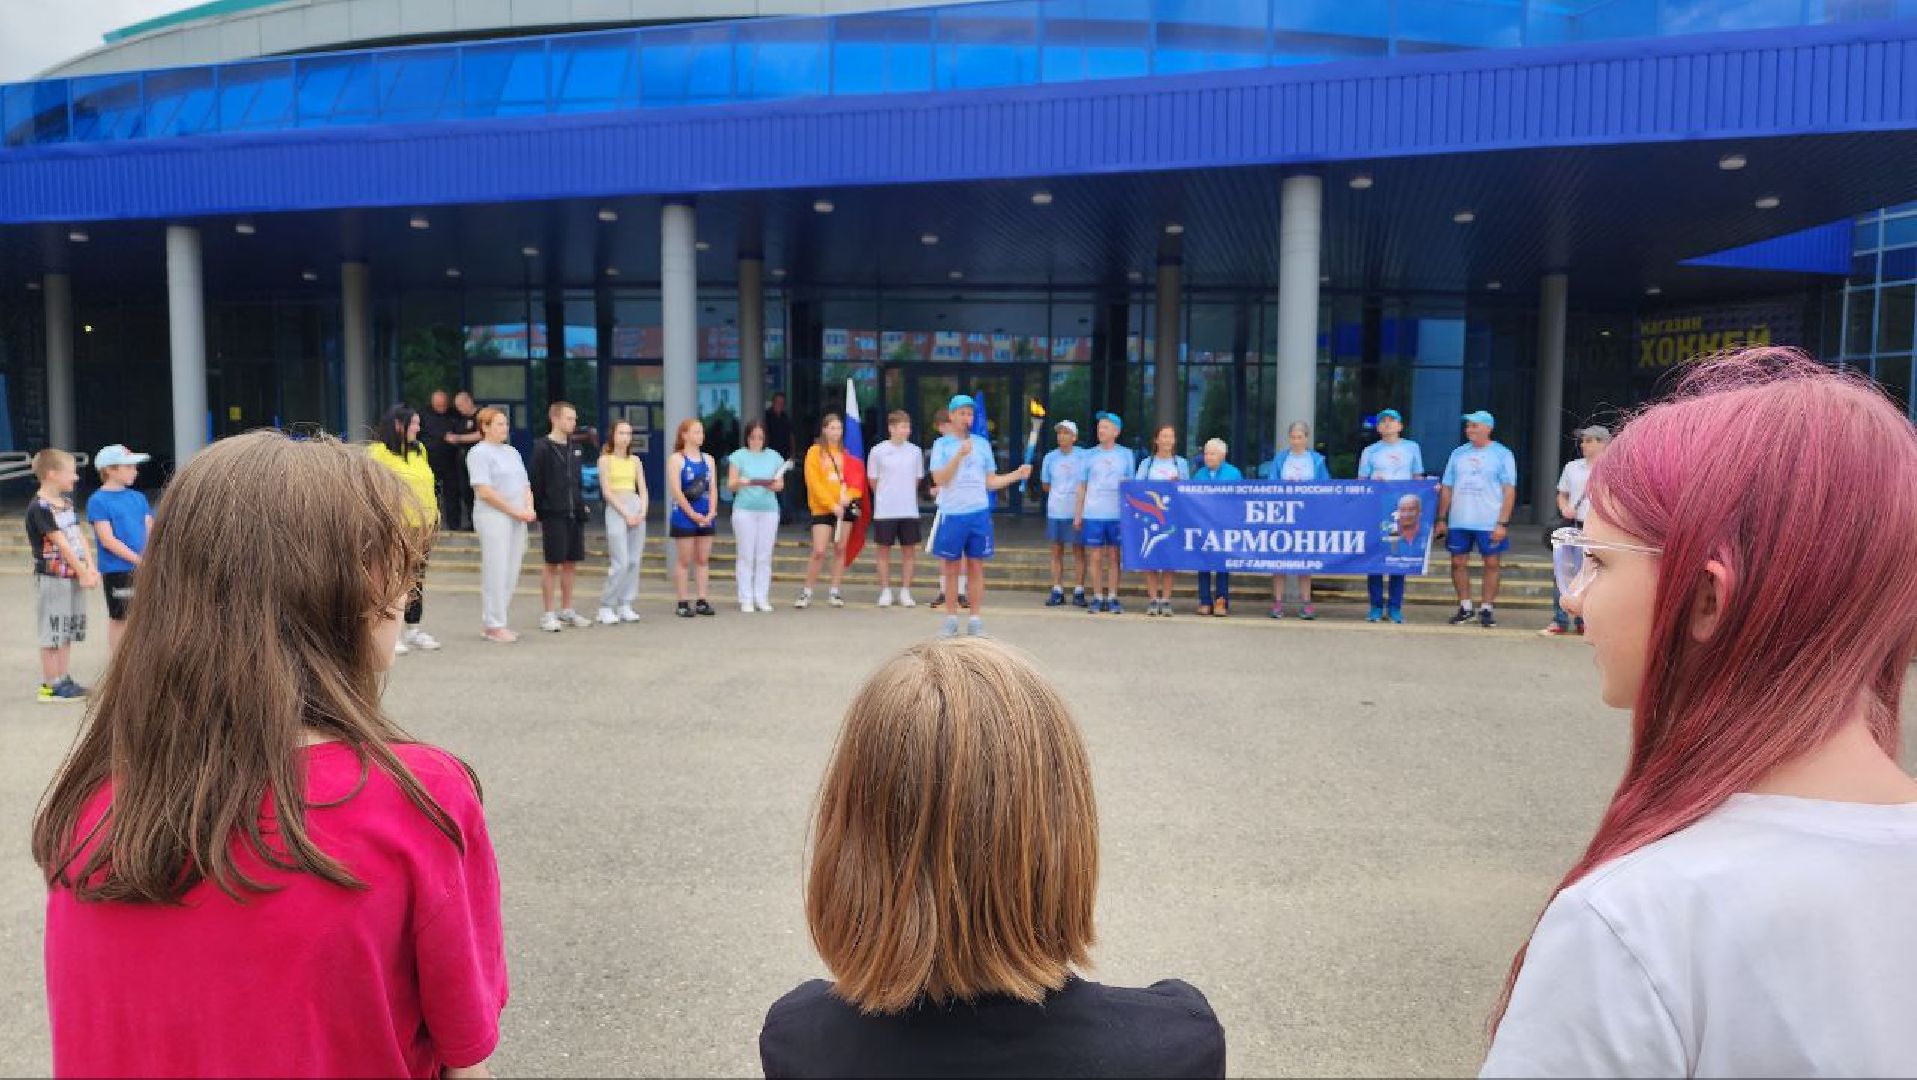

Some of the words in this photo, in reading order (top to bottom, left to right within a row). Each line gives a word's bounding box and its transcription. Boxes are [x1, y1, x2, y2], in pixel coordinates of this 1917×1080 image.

[1641, 317, 1702, 335] МАГАЗИН
[1177, 485, 1233, 495] ФАКЕЛЬНАЯ
[1235, 485, 1284, 495] ЭСТАФЕТА
[1286, 485, 1293, 495] В
[1295, 485, 1333, 494] РОССИИ
[1335, 485, 1342, 494] С
[1245, 500, 1304, 524] БЕГ
[1183, 528, 1366, 553] ГАРМОНИИ
[1225, 559, 1323, 569] БЕГ-ГАРМОНИИ.РФ
